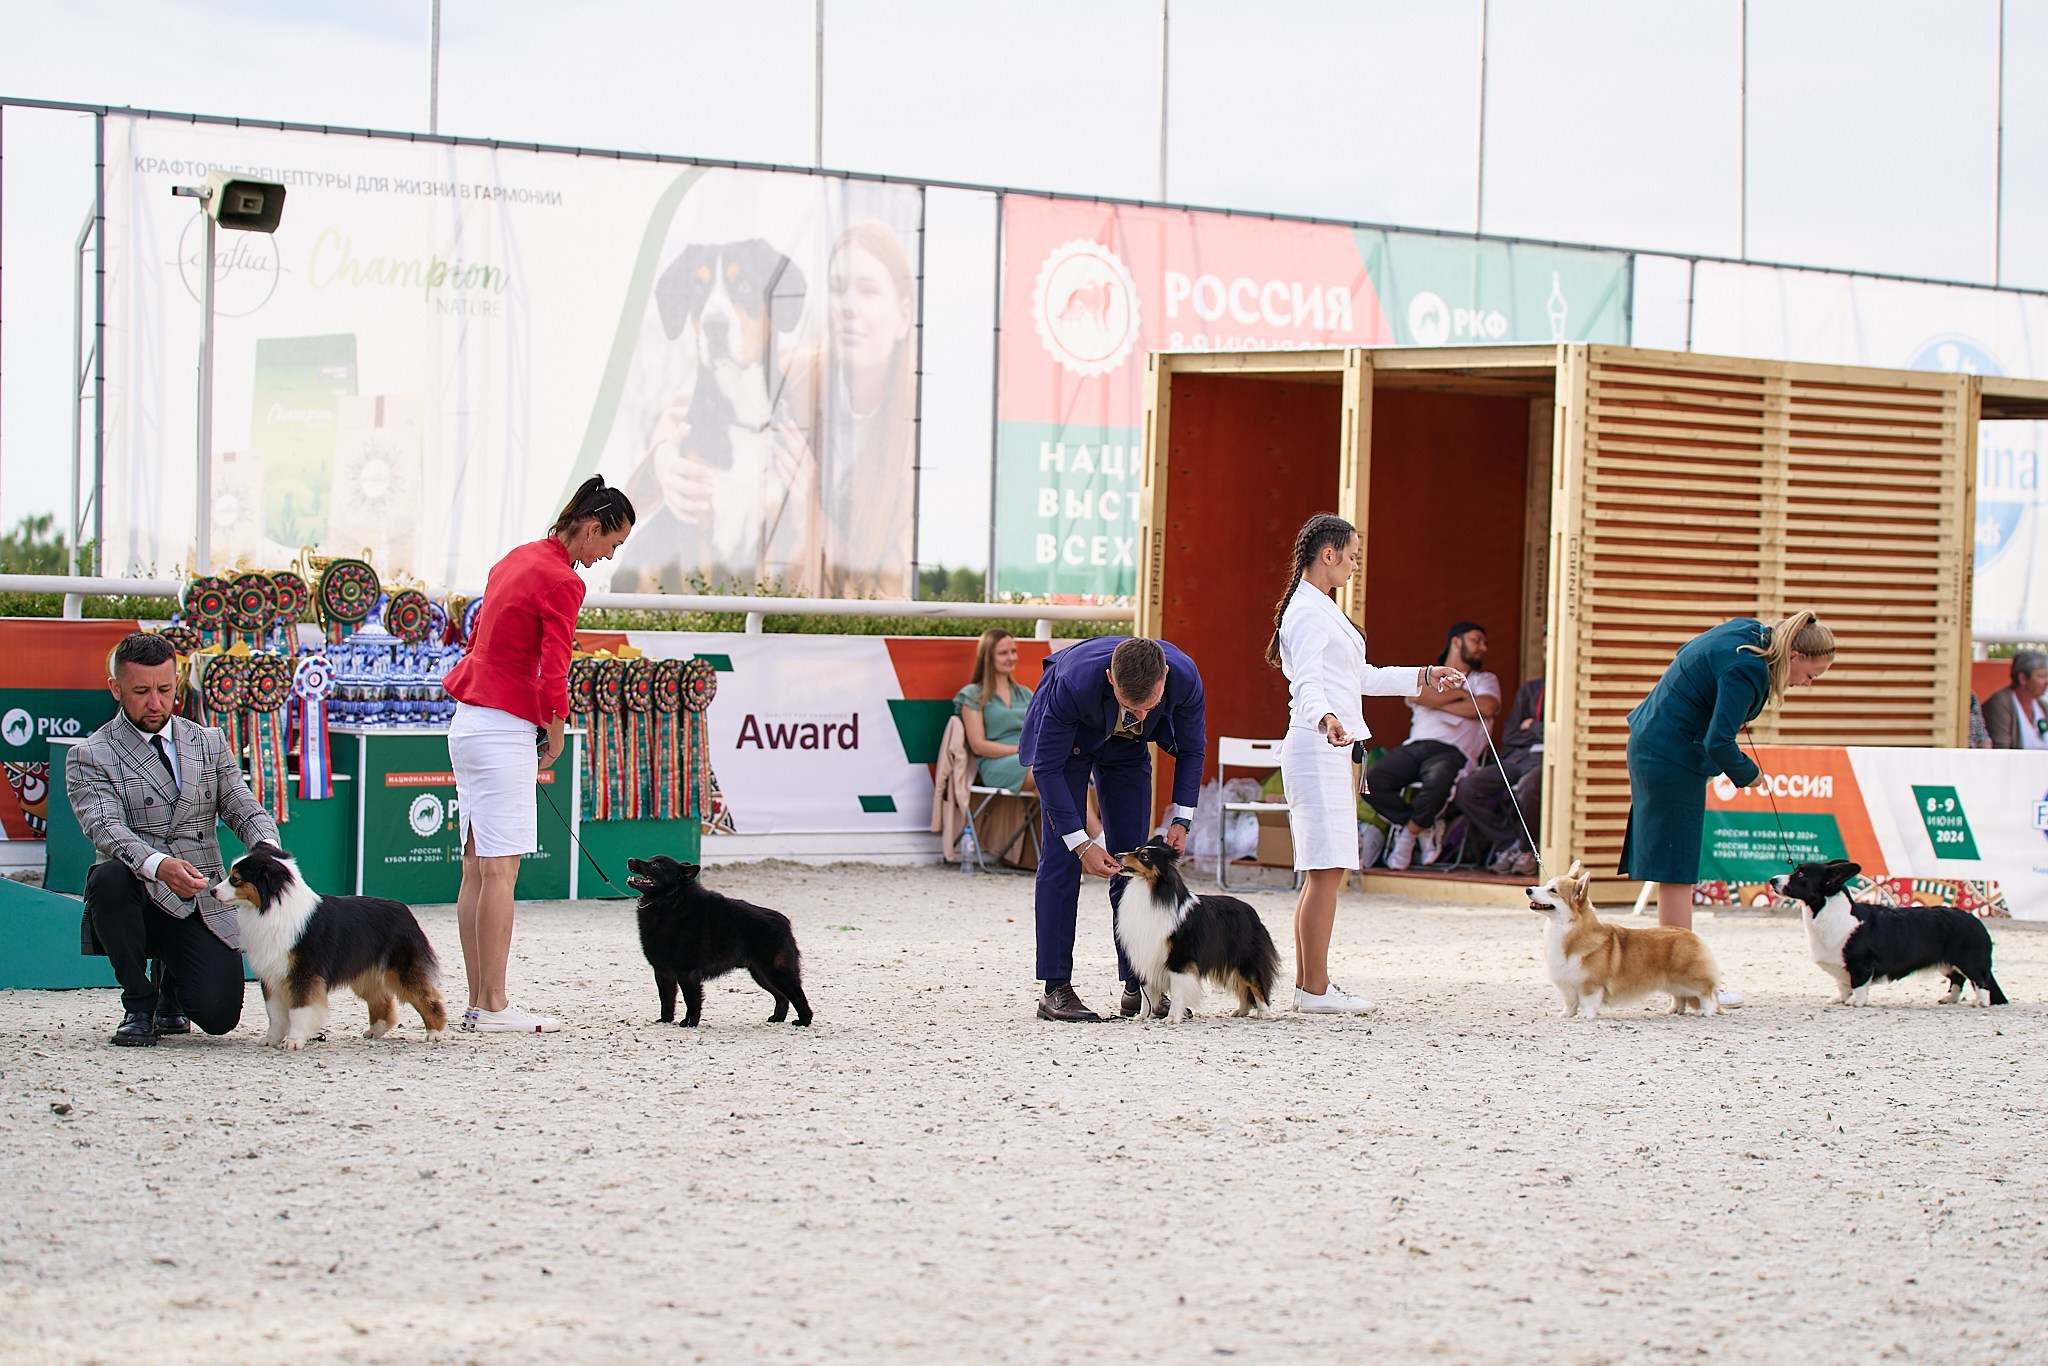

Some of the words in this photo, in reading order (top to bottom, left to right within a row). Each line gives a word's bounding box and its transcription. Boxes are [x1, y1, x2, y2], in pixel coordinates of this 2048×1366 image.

[356, 175, 389, 194] ДЛЯ
[393, 178, 456, 197] ЖИЗНИ
[460, 184, 470, 199] В
[475, 185, 562, 206] ГАРМОНИИ
[307, 226, 510, 304] Champion
[436, 298, 502, 316] NATURE
[1164, 271, 1353, 332] РОССИЯ
[1454, 307, 1508, 338] РКФ
[1035, 533, 1134, 567] ВСЕХ
[1152, 531, 1162, 606] CORNER
[37, 717, 81, 736] РКФ
[736, 713, 859, 750] Award
[1926, 797, 1955, 812] 8-9
[1926, 815, 1963, 827] ИЮНЯ
[1752, 829, 1778, 839] КУБОК
[1936, 830, 1965, 843] 2024
[1713, 850, 1737, 858] КУБОК
